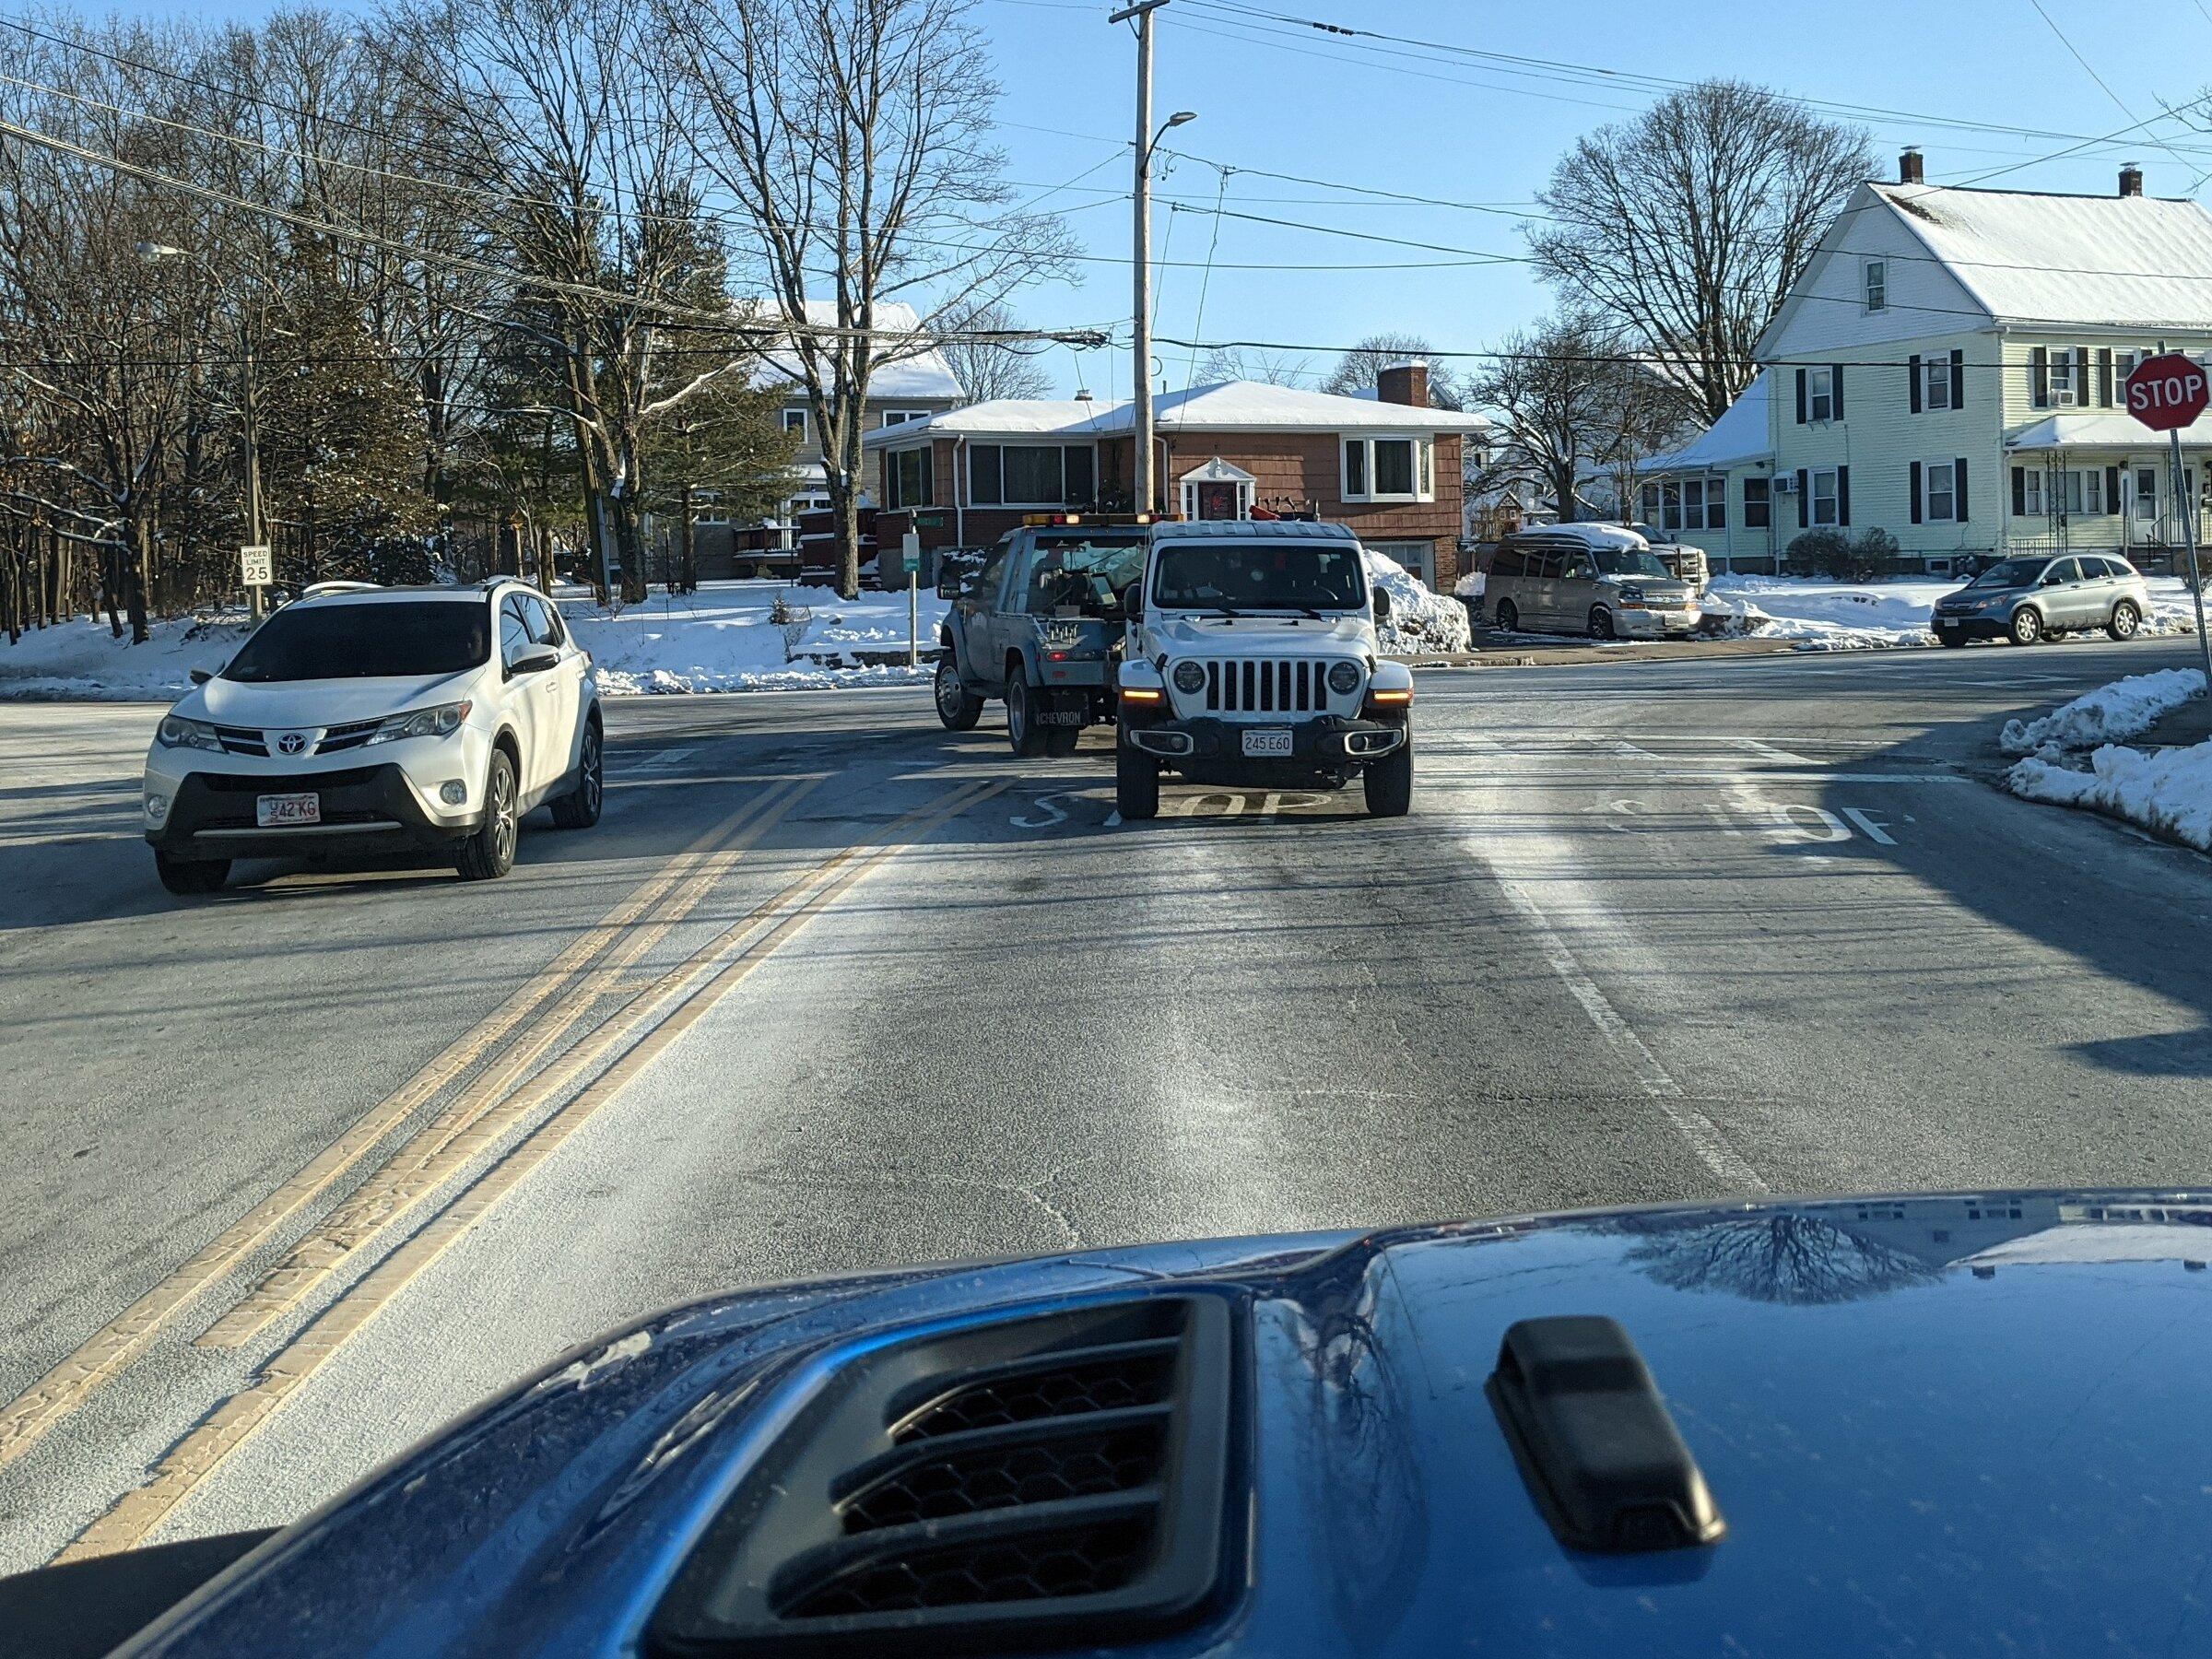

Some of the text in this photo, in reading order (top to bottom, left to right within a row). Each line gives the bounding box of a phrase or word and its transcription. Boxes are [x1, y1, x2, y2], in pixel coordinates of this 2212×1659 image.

[2131, 374, 2202, 410] STOP
[246, 567, 267, 581] 25
[1040, 712, 1080, 724] CHEVRON
[1009, 793, 1333, 828] SOP
